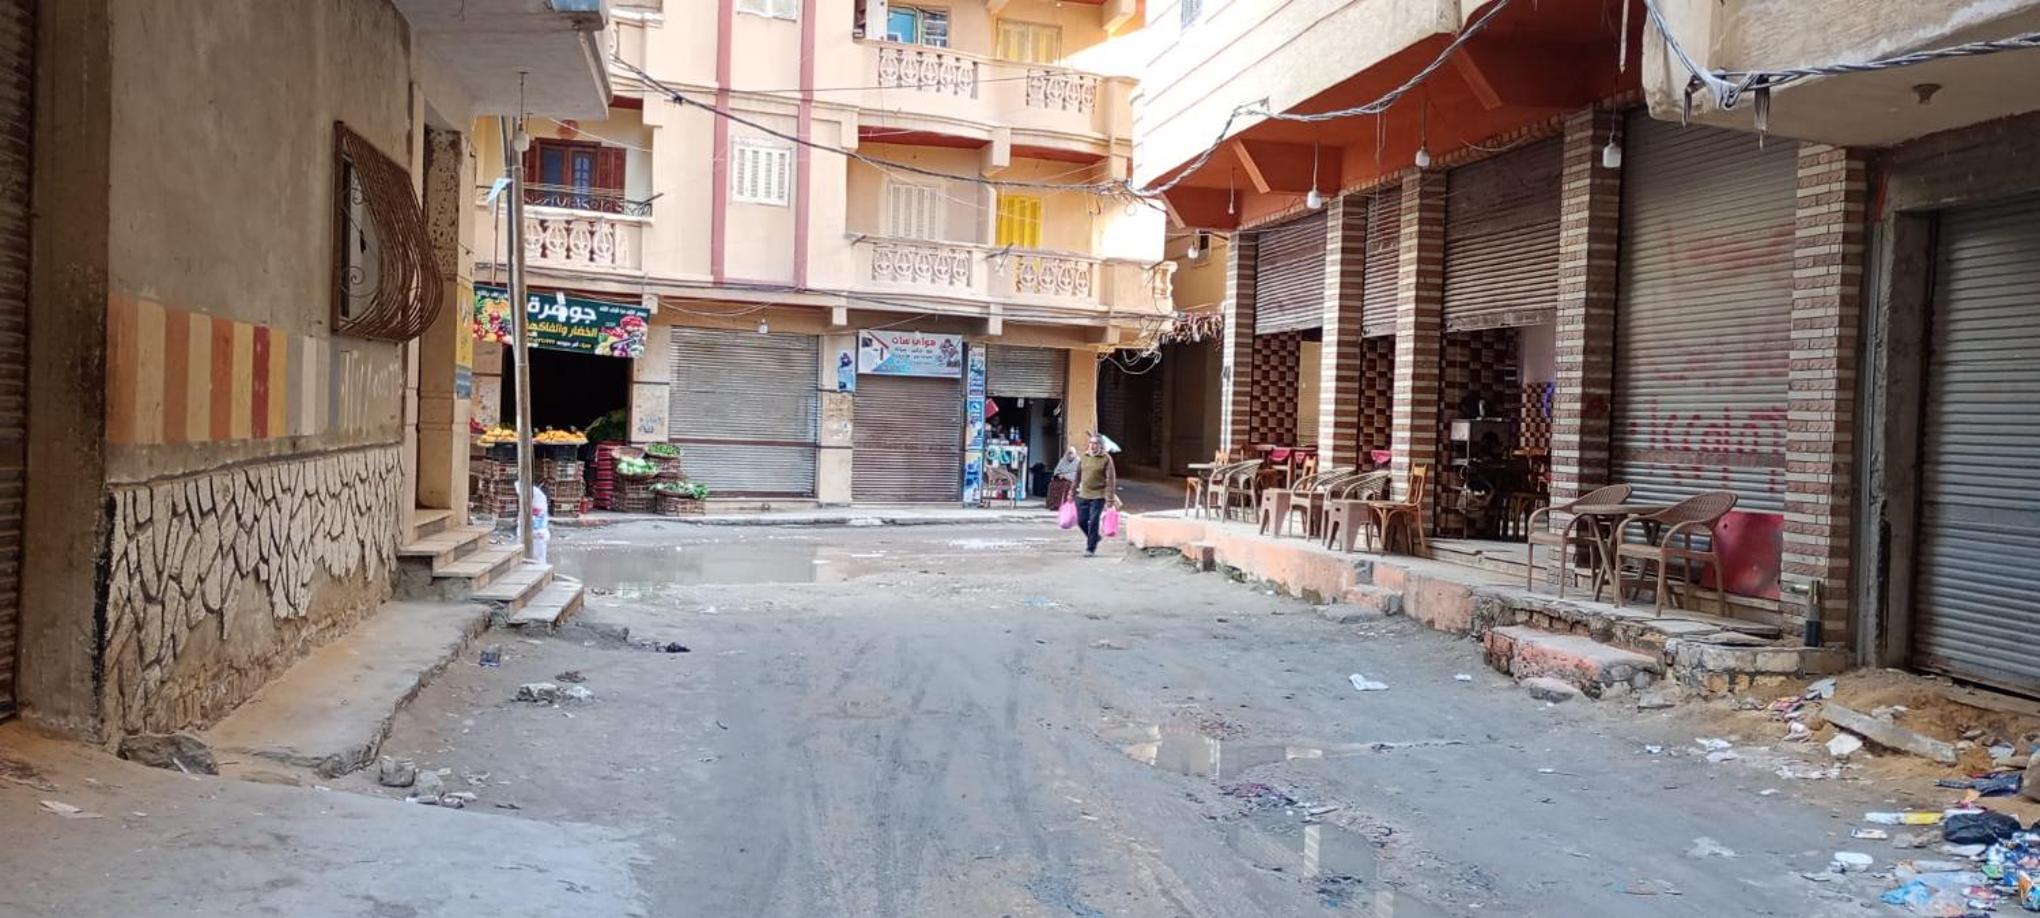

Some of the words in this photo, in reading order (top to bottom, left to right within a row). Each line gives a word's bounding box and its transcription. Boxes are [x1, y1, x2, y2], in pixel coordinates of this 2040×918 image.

[527, 296, 598, 324] جوهرة
[527, 321, 568, 336] والفاكه
[568, 325, 598, 337] الخضار
